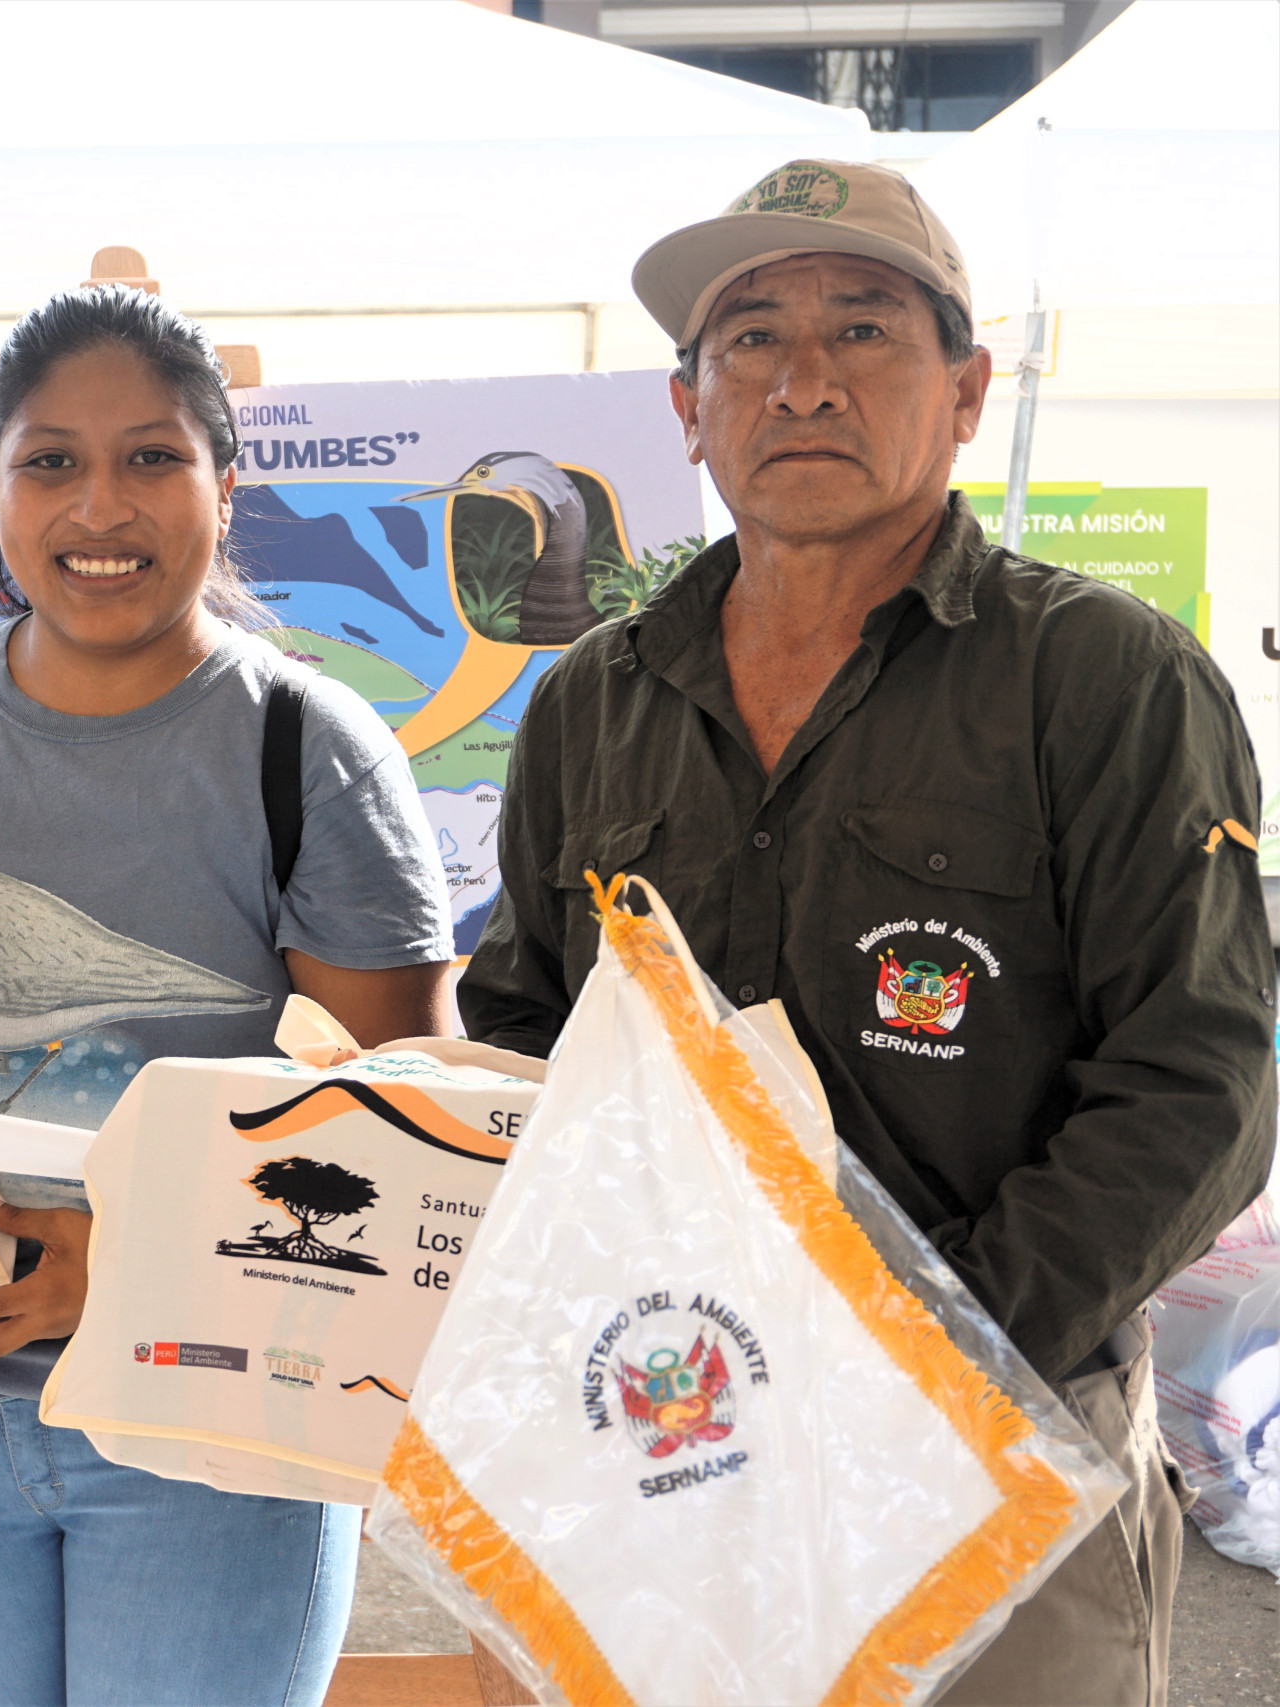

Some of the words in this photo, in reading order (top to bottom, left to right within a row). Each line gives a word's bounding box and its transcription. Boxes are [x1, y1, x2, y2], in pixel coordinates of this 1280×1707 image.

[758, 180, 778, 199] YO
[784, 172, 820, 194] SOY
[978, 514, 1075, 534] USTRA
[1082, 508, 1166, 534] MISIÓN
[1084, 561, 1159, 576] CUIDADO
[1164, 562, 1174, 575] Y
[464, 742, 480, 750] Las
[476, 794, 496, 802] Hito
[444, 864, 472, 873] ector
[855, 918, 918, 954] Ministerio
[924, 918, 948, 935] del
[950, 927, 1000, 978] Ambiente
[860, 1030, 966, 1060] SERNANP
[417, 1224, 462, 1255] Los
[243, 1268, 290, 1283] Ministerio
[292, 1275, 308, 1286] del
[309, 1278, 356, 1296] Ambiente
[414, 1261, 450, 1290] de
[156, 1348, 177, 1358] PERÚ
[181, 1347, 220, 1358] Ministerio
[181, 1356, 193, 1364] del
[194, 1357, 232, 1368] Ambiente
[582, 1312, 630, 1432] MINISTERIO
[636, 1290, 677, 1317] DEL
[688, 1293, 768, 1386] AMBIENTE
[265, 1356, 321, 1381] TIERRA
[272, 1372, 287, 1380] SOLO
[300, 1378, 314, 1386] UNA
[639, 1450, 748, 1498] SERNANP
